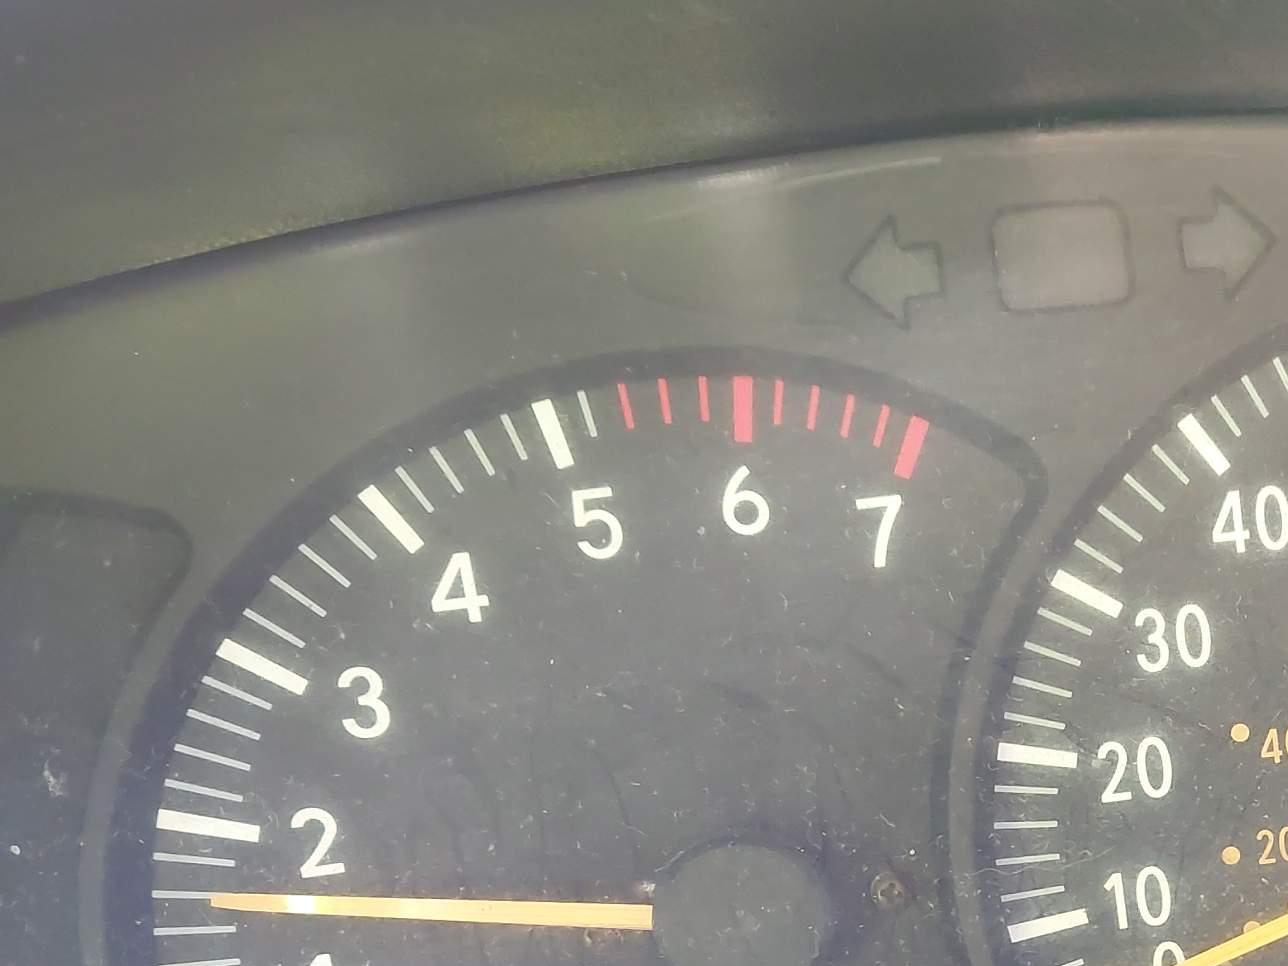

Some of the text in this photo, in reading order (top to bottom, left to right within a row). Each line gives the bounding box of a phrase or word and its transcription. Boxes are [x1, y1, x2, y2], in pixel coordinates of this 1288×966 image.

[570, 486, 625, 560] 5
[720, 465, 772, 536] 6
[856, 494, 905, 569] 7
[430, 552, 490, 624] 4
[1134, 603, 1212, 673] 30
[336, 666, 392, 739] 3
[1097, 736, 1173, 803] 20
[290, 807, 346, 880] 2
[1103, 864, 1173, 931] 10
